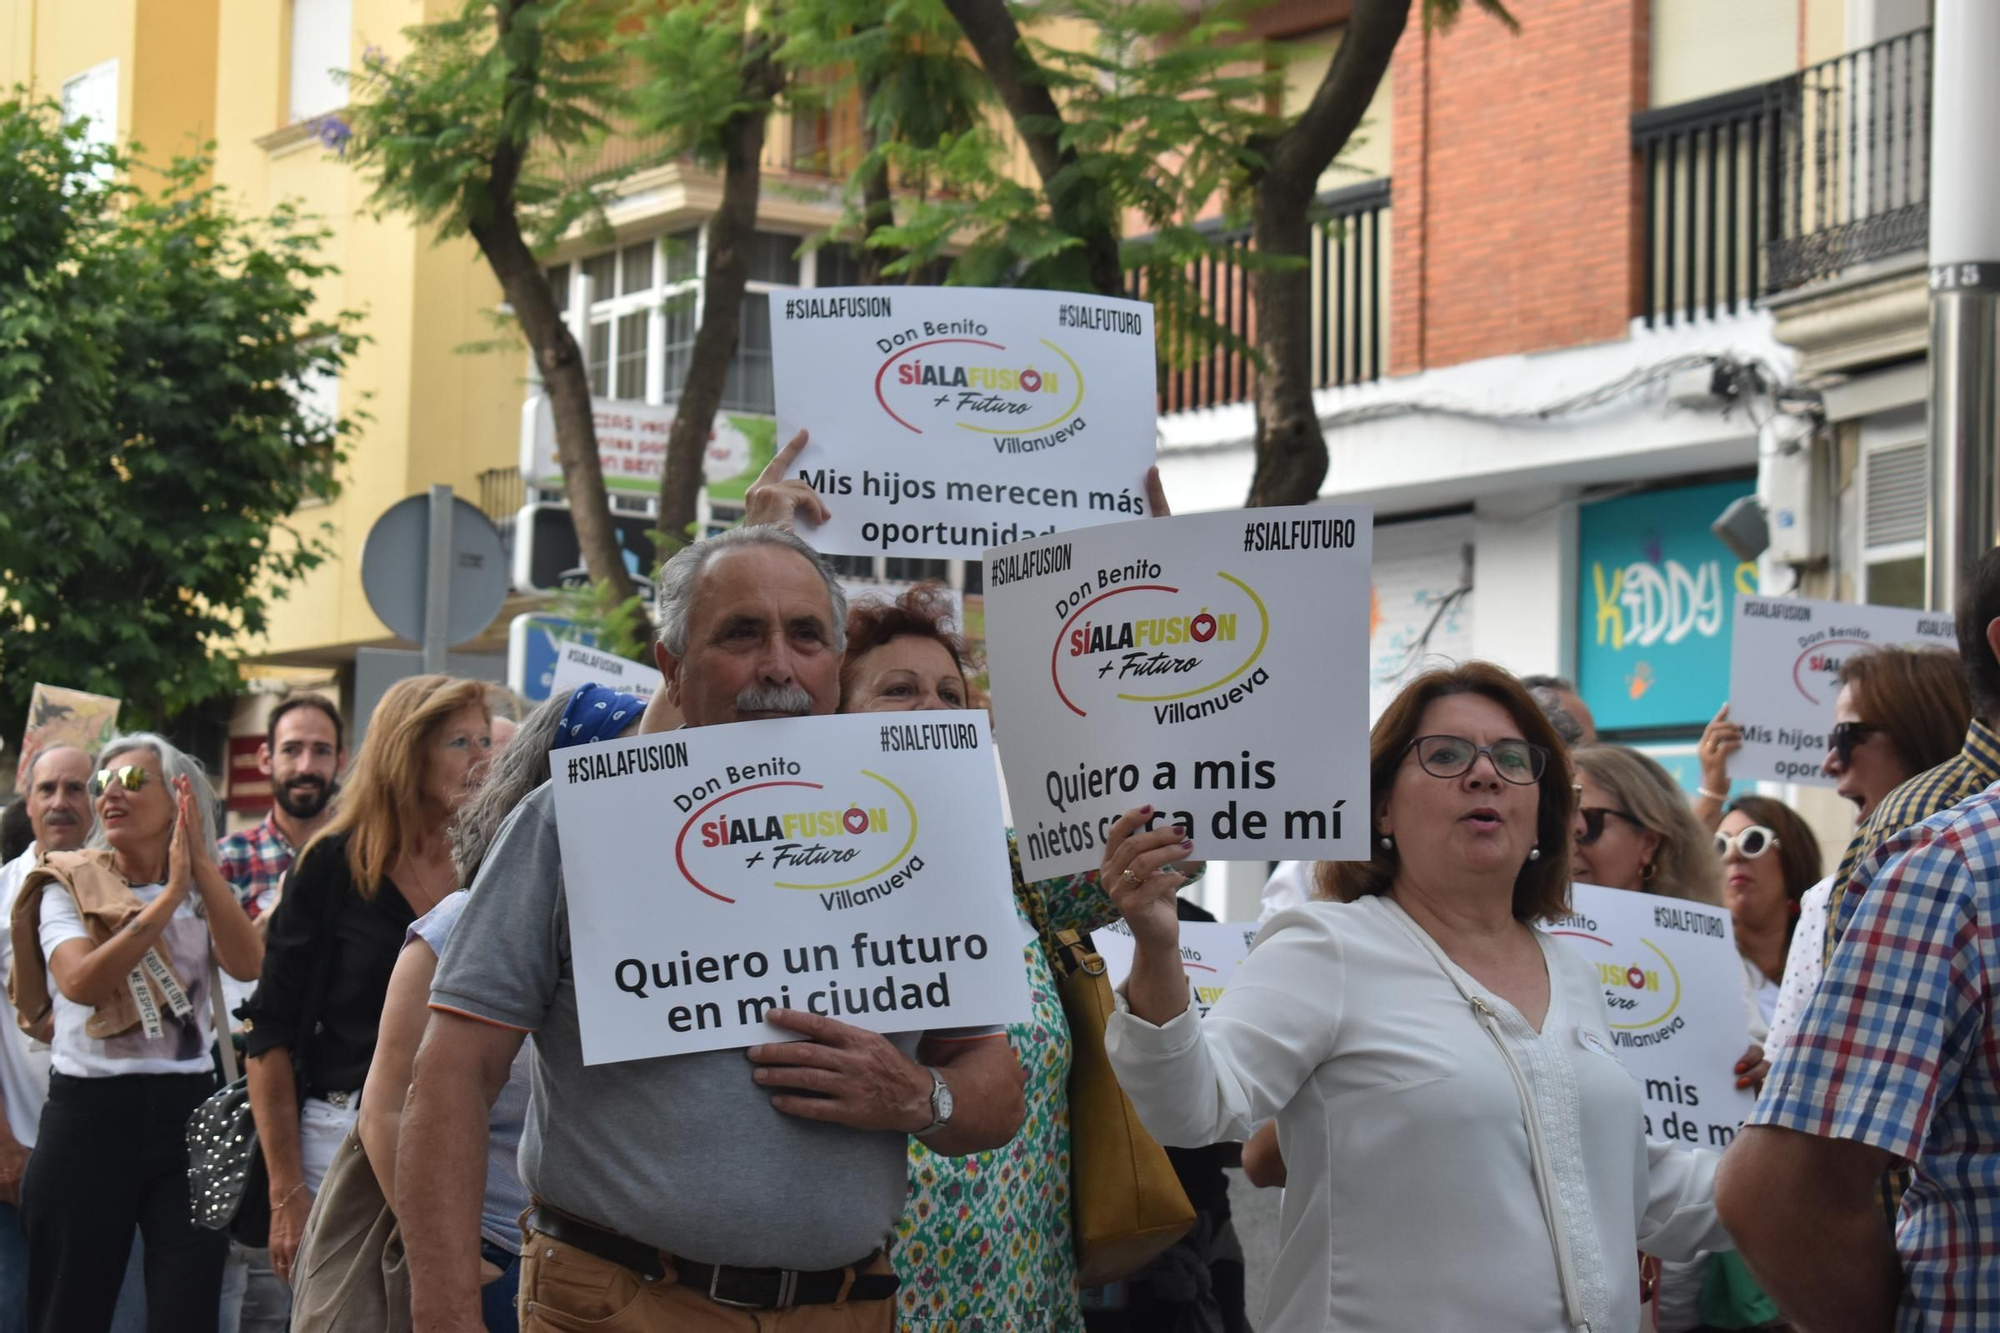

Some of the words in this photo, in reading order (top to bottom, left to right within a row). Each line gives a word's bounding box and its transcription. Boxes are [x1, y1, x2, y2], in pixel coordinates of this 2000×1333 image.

[786, 297, 892, 320] #SIALAFUSION
[1059, 304, 1142, 335] #SIALFUTURO
[876, 328, 919, 354] Don
[923, 319, 988, 337] Benito
[955, 391, 1033, 415] Futuro
[993, 416, 1087, 454] Villanueva
[799, 469, 852, 495] Mis
[862, 471, 936, 505] hijos
[946, 479, 1078, 508] merecen
[1089, 487, 1144, 515] más
[861, 520, 1056, 549] oportunida
[1243, 518, 1355, 552] #SIALFUTURO
[991, 543, 1073, 587] #SIALAFUSION
[1055, 581, 1092, 620] Don
[1097, 559, 1162, 590] Benito
[1743, 601, 1812, 622] #SIALAFUSION
[1797, 631, 1825, 649] Don
[1828, 626, 1870, 640] Benito
[1119, 651, 1203, 680] Futuro
[1154, 666, 1270, 725] Villanueva
[880, 723, 978, 752] #SIALFUTURO
[1739, 724, 1772, 744] Mis
[1778, 726, 1824, 751] hijos
[567, 742, 689, 785] #SIALAFUSION
[673, 774, 722, 814] Don
[726, 756, 801, 785] Benito
[1046, 762, 1140, 813] Quiero
[1152, 762, 1177, 790] a
[1194, 750, 1276, 790] mis
[1026, 816, 1094, 861] nietos
[1098, 810, 1194, 846] cca
[1211, 800, 1268, 840] de
[1284, 800, 1347, 840] mí
[772, 844, 861, 870] Futuro
[819, 854, 926, 912] Villanueva
[1654, 905, 1725, 939] #SIALFUTURO
[145, 951, 166, 977] TRUST
[168, 988, 187, 1011] LOVE
[614, 949, 769, 998] Quiero
[783, 944, 840, 974] un
[851, 932, 988, 968] futuro
[136, 985, 158, 1023] RESPECT
[667, 1001, 722, 1033] en
[738, 984, 791, 1026] mi
[807, 971, 951, 1018] ciudad
[1610, 1015, 1686, 1048] Villanueva
[1646, 1076, 1699, 1107] mis
[1662, 1111, 1699, 1143] de
